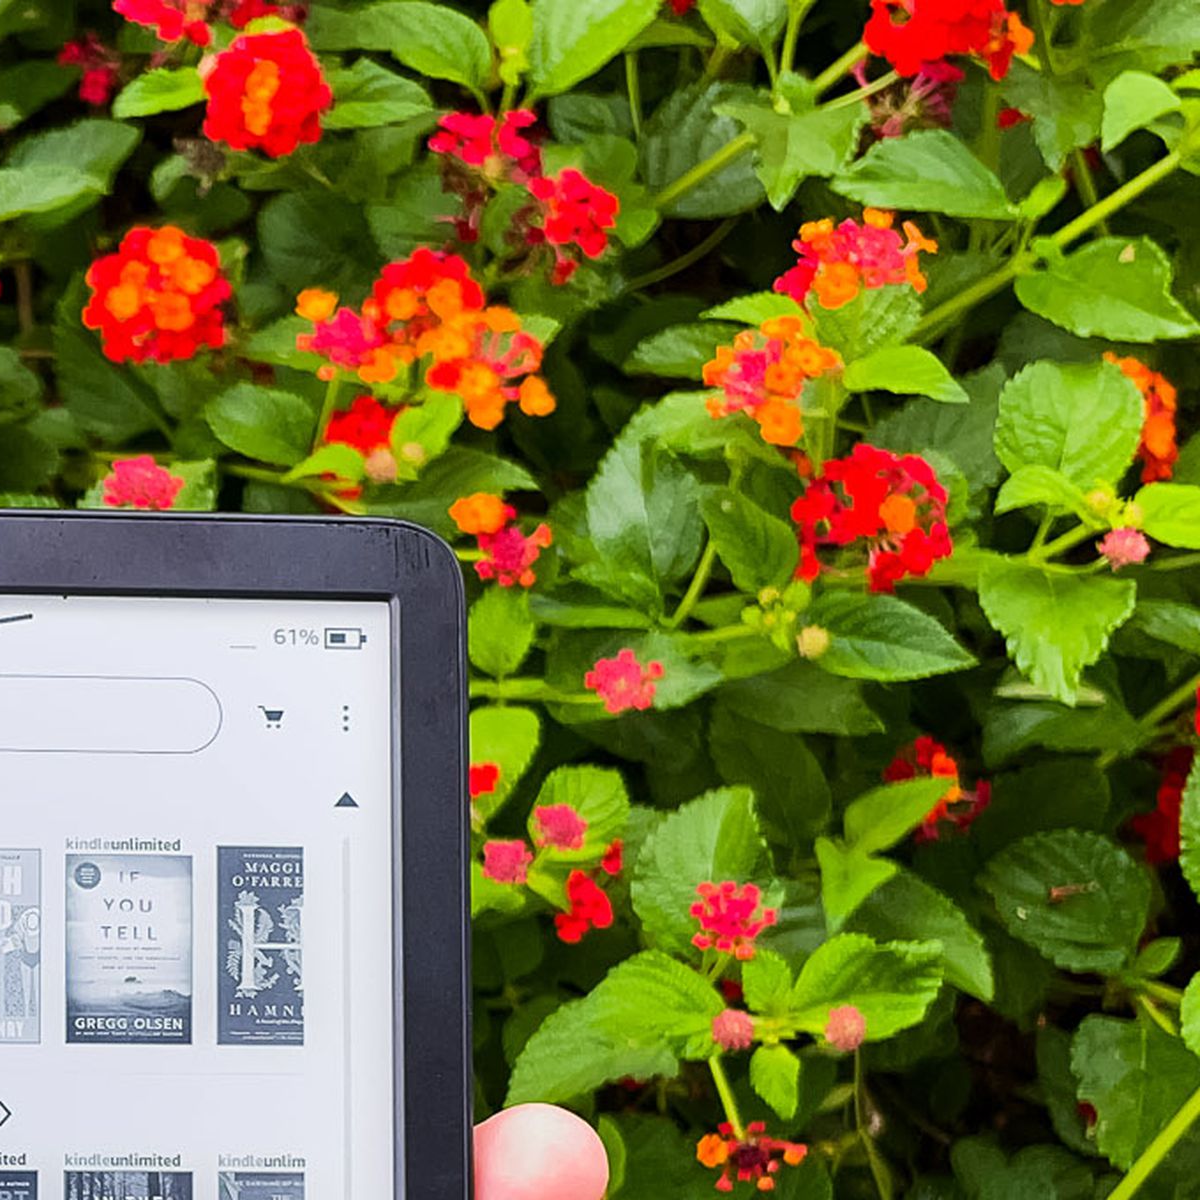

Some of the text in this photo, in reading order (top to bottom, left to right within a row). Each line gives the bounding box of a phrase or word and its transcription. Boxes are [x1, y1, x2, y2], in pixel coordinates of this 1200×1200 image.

[274, 629, 319, 645] 61%
[245, 862, 302, 873] MAGGI
[119, 871, 141, 883] IF
[103, 898, 153, 912] YOU
[101, 926, 158, 941] TELL
[75, 1017, 183, 1030] GREGG OLSEN
